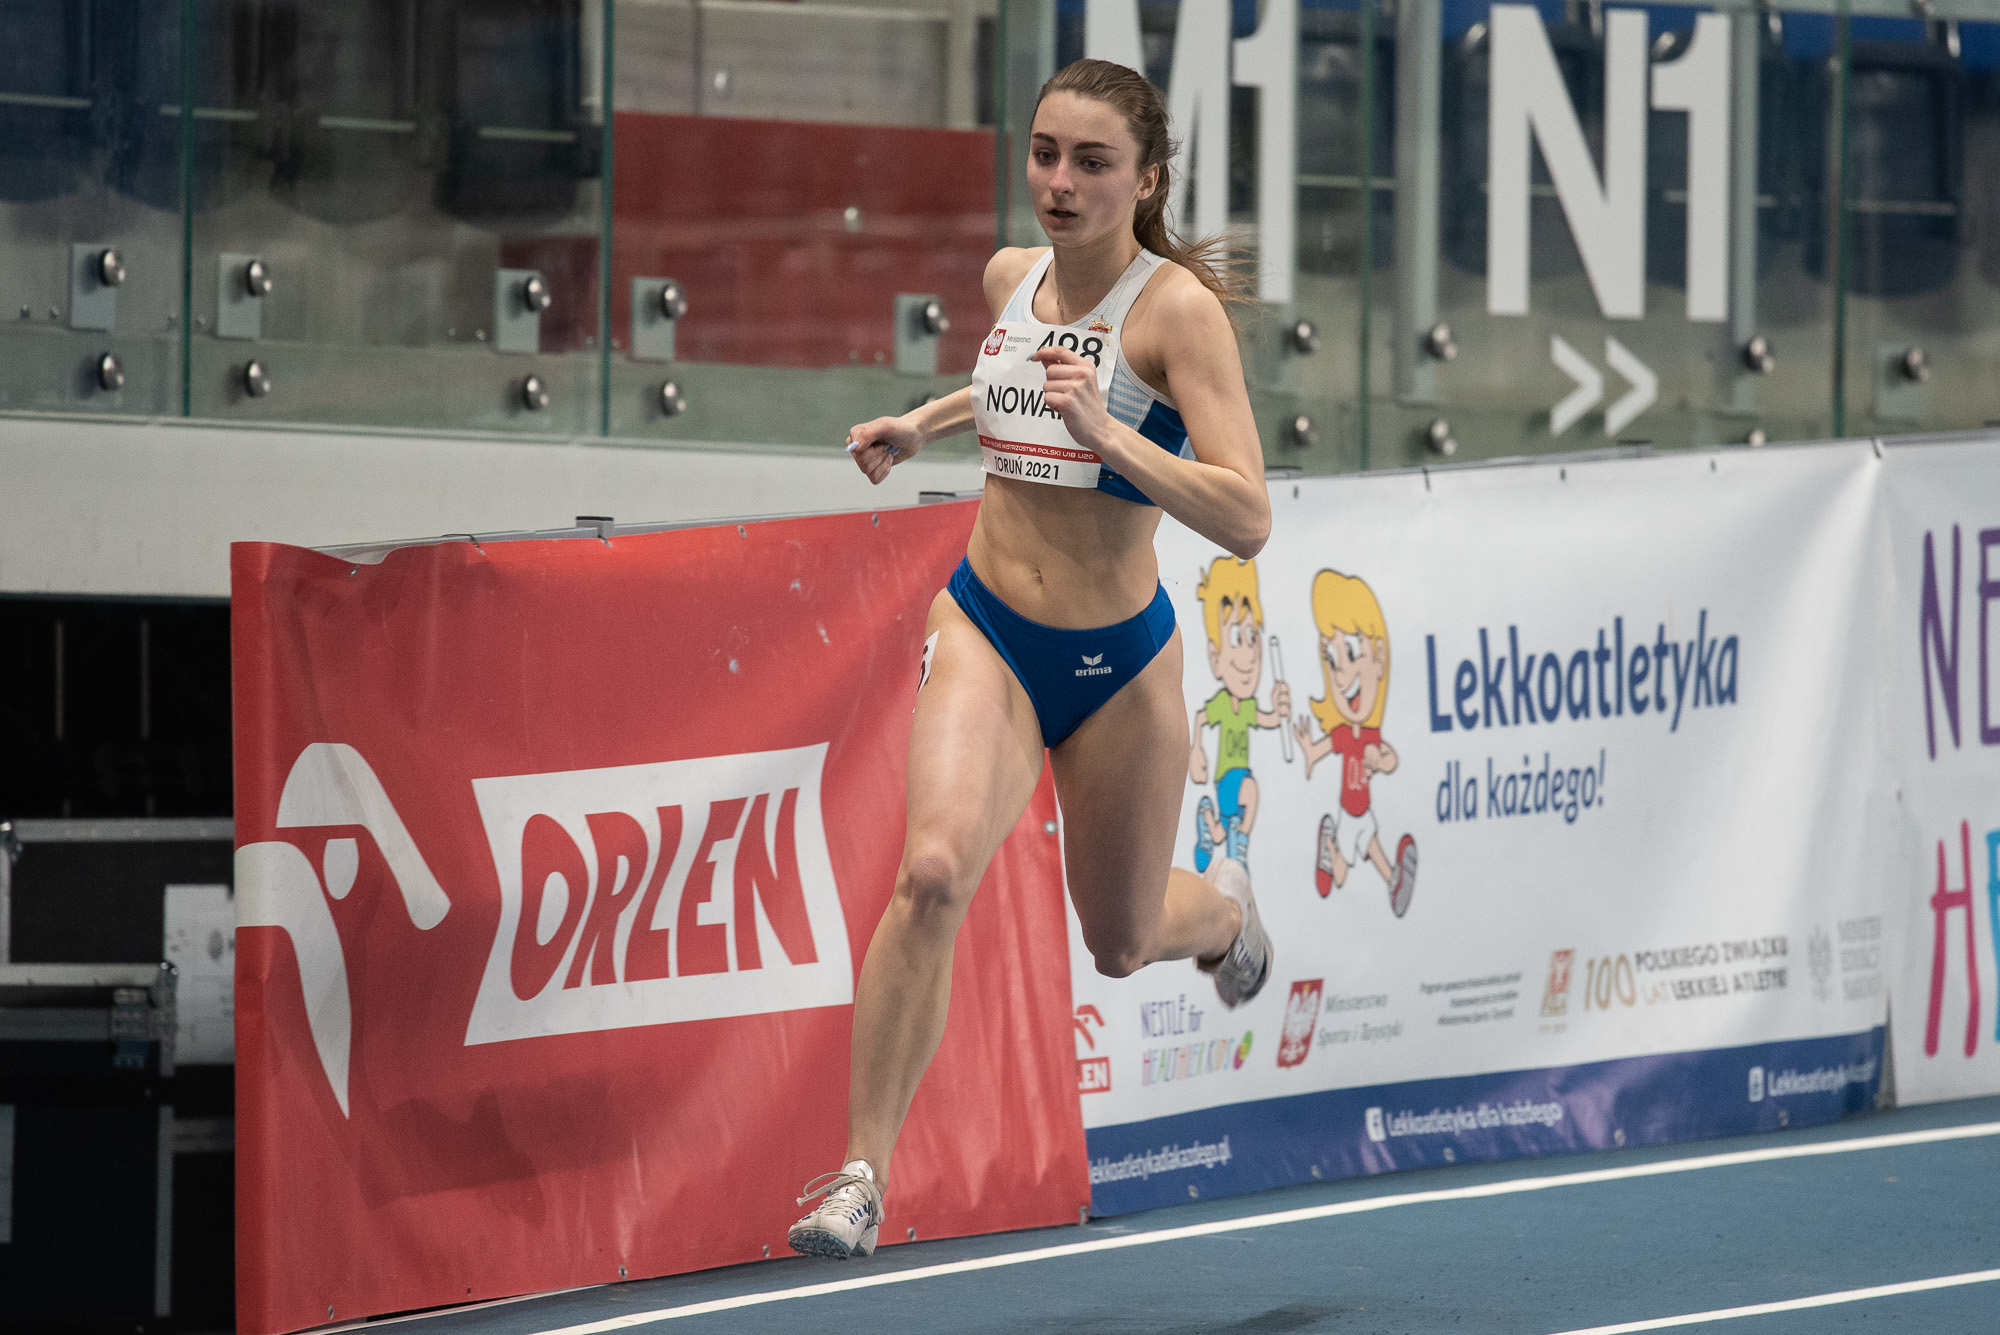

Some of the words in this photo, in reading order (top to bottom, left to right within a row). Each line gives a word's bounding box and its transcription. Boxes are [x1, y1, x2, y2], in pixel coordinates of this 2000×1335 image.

[1488, 4, 1729, 323] N1
[994, 455, 1023, 475] TORUŃ
[1025, 461, 1060, 480] 2021
[1038, 448, 1061, 456] POLSKI
[1075, 665, 1112, 677] erima
[1426, 609, 1739, 733] Lekkoatletyka
[1436, 760, 1478, 823] dla
[1487, 747, 1606, 825] każdego!
[509, 787, 820, 1001] ORLEN
[1584, 953, 1637, 1011] 100
